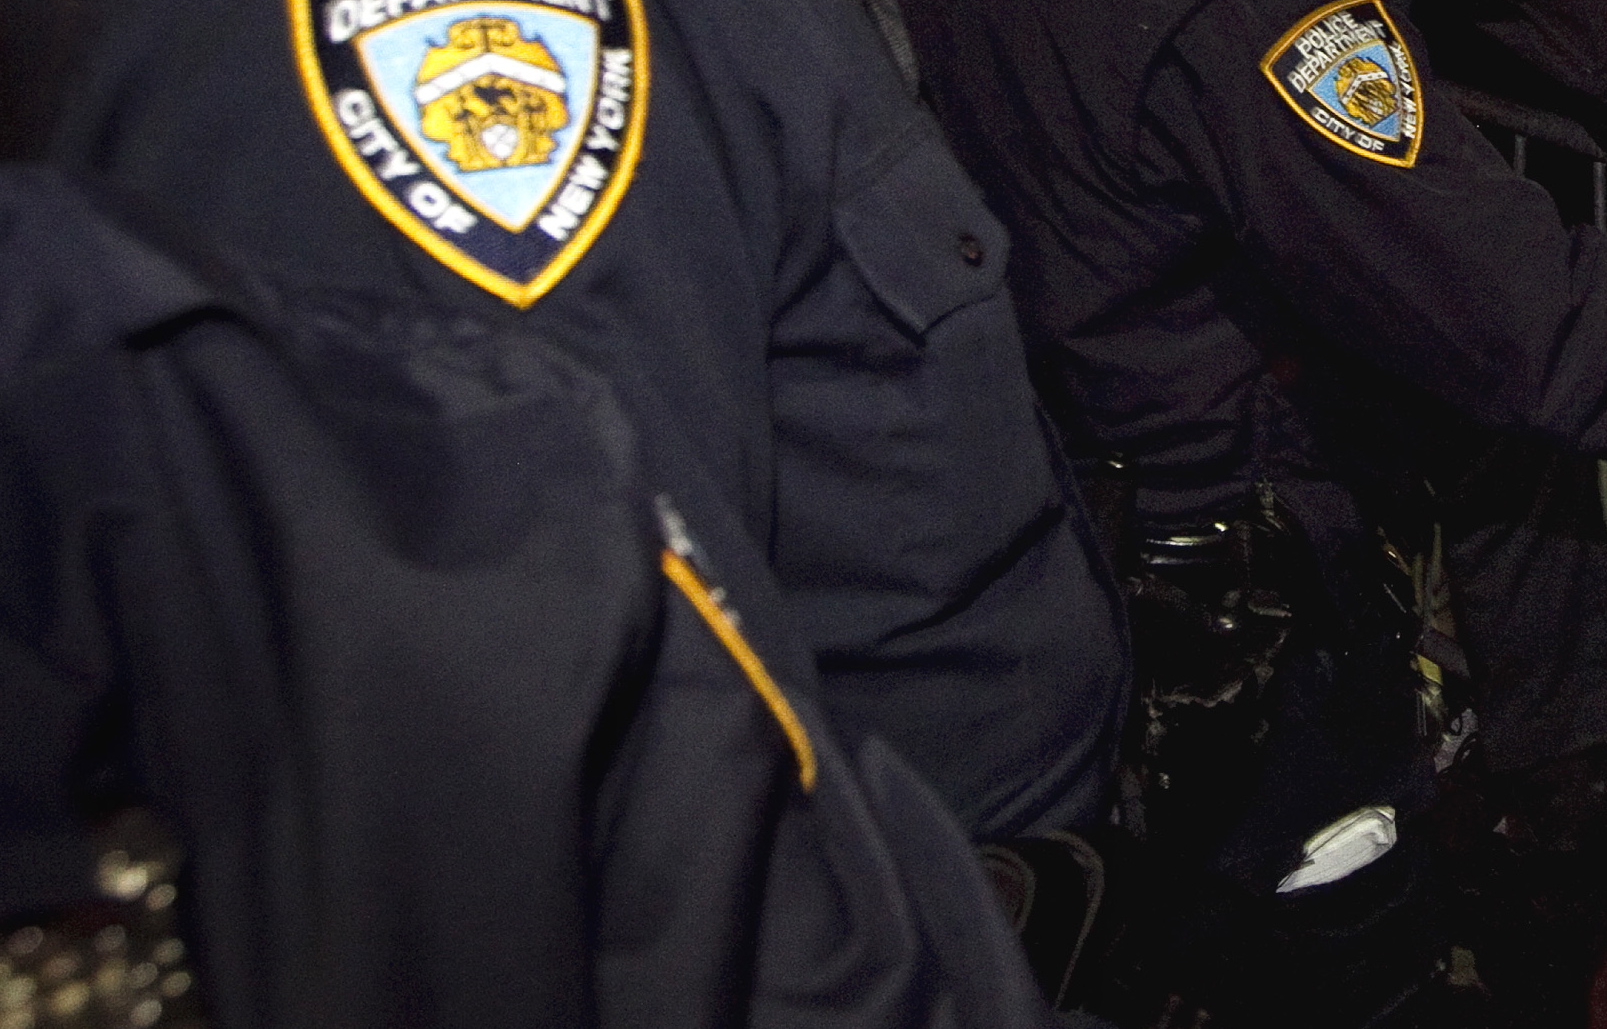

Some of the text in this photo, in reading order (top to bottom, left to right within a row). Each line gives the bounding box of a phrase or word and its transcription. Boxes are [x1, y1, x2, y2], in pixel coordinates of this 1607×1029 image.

[1287, 19, 1387, 94] DEPARTMENT
[1294, 10, 1359, 60] POLICE
[536, 46, 634, 241] NEW YORK
[1309, 106, 1386, 152] CITY OF
[1400, 97, 1417, 139] NEW
[334, 87, 478, 234] CITY OF
